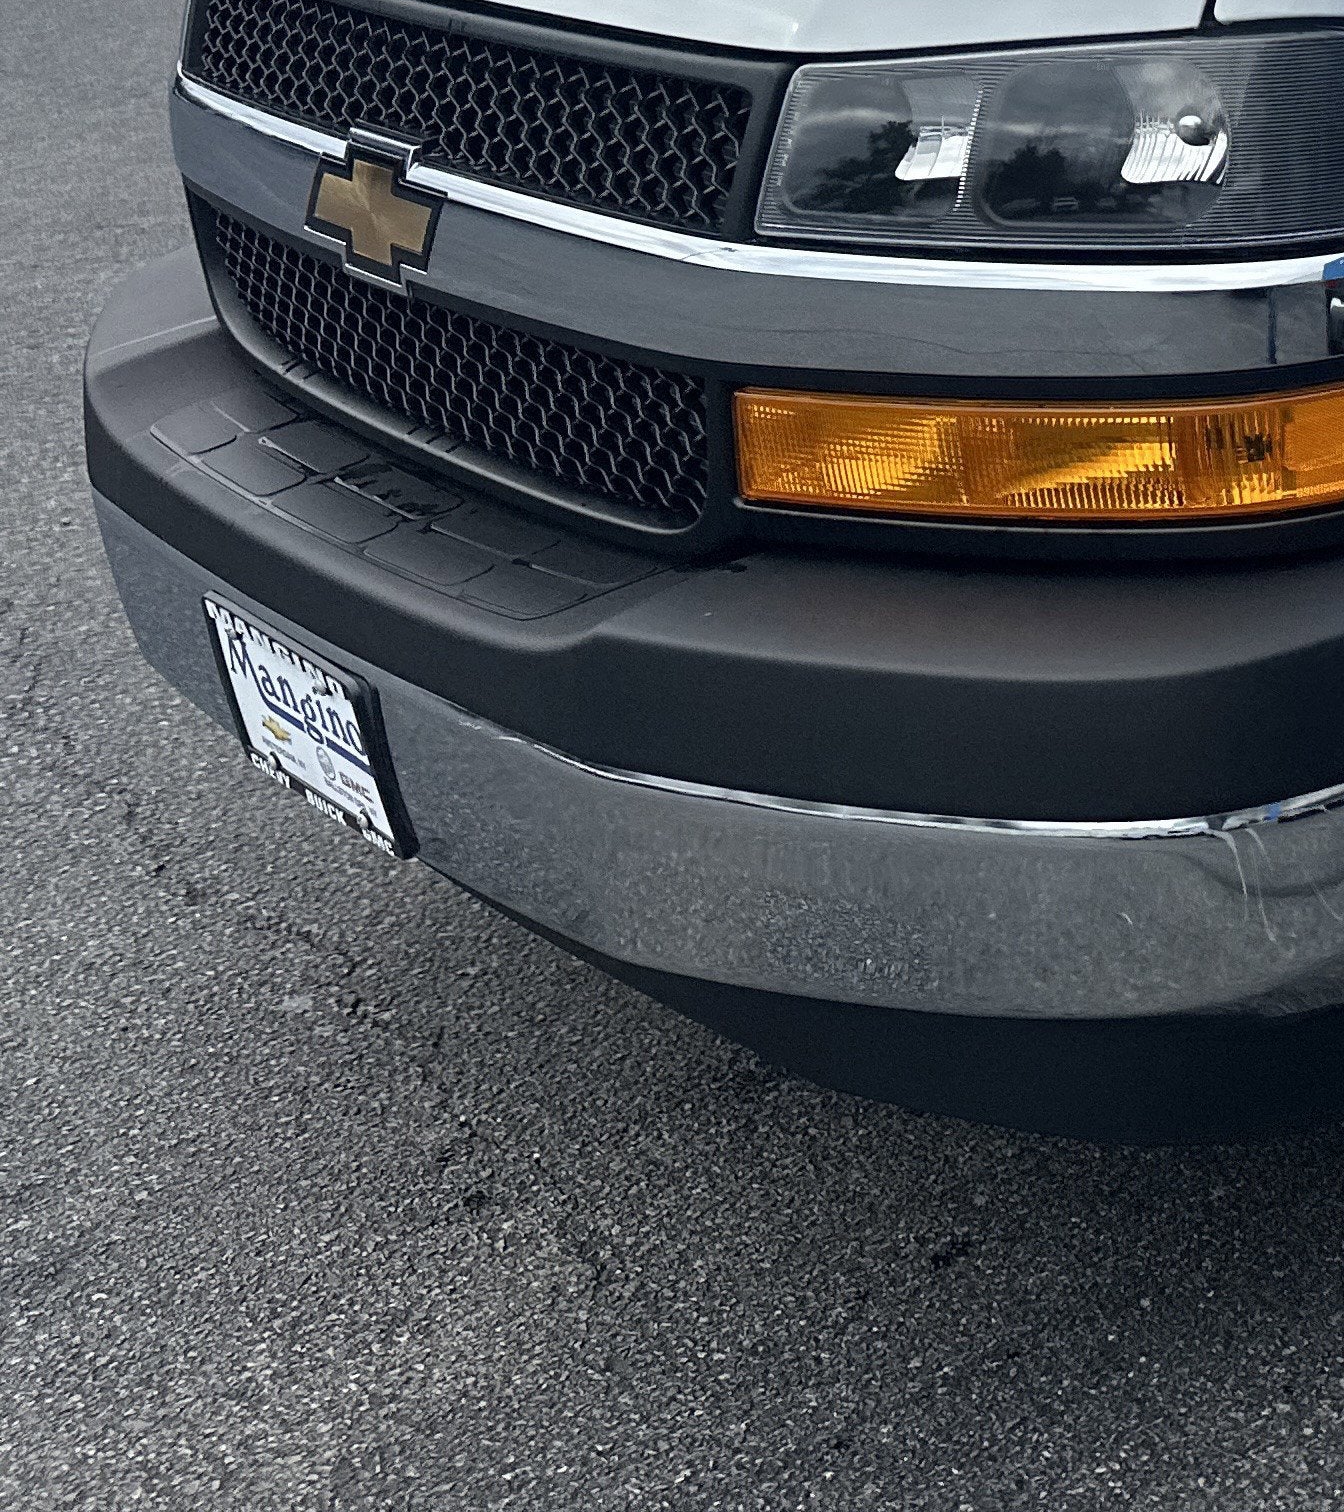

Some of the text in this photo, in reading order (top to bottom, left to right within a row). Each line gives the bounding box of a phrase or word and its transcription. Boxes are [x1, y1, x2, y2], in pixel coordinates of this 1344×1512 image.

[203, 598, 347, 700] MANGINO
[226, 636, 369, 756] Mangino
[251, 753, 290, 788] CHEVY
[305, 789, 347, 826] BUICK
[339, 772, 375, 804] GMC
